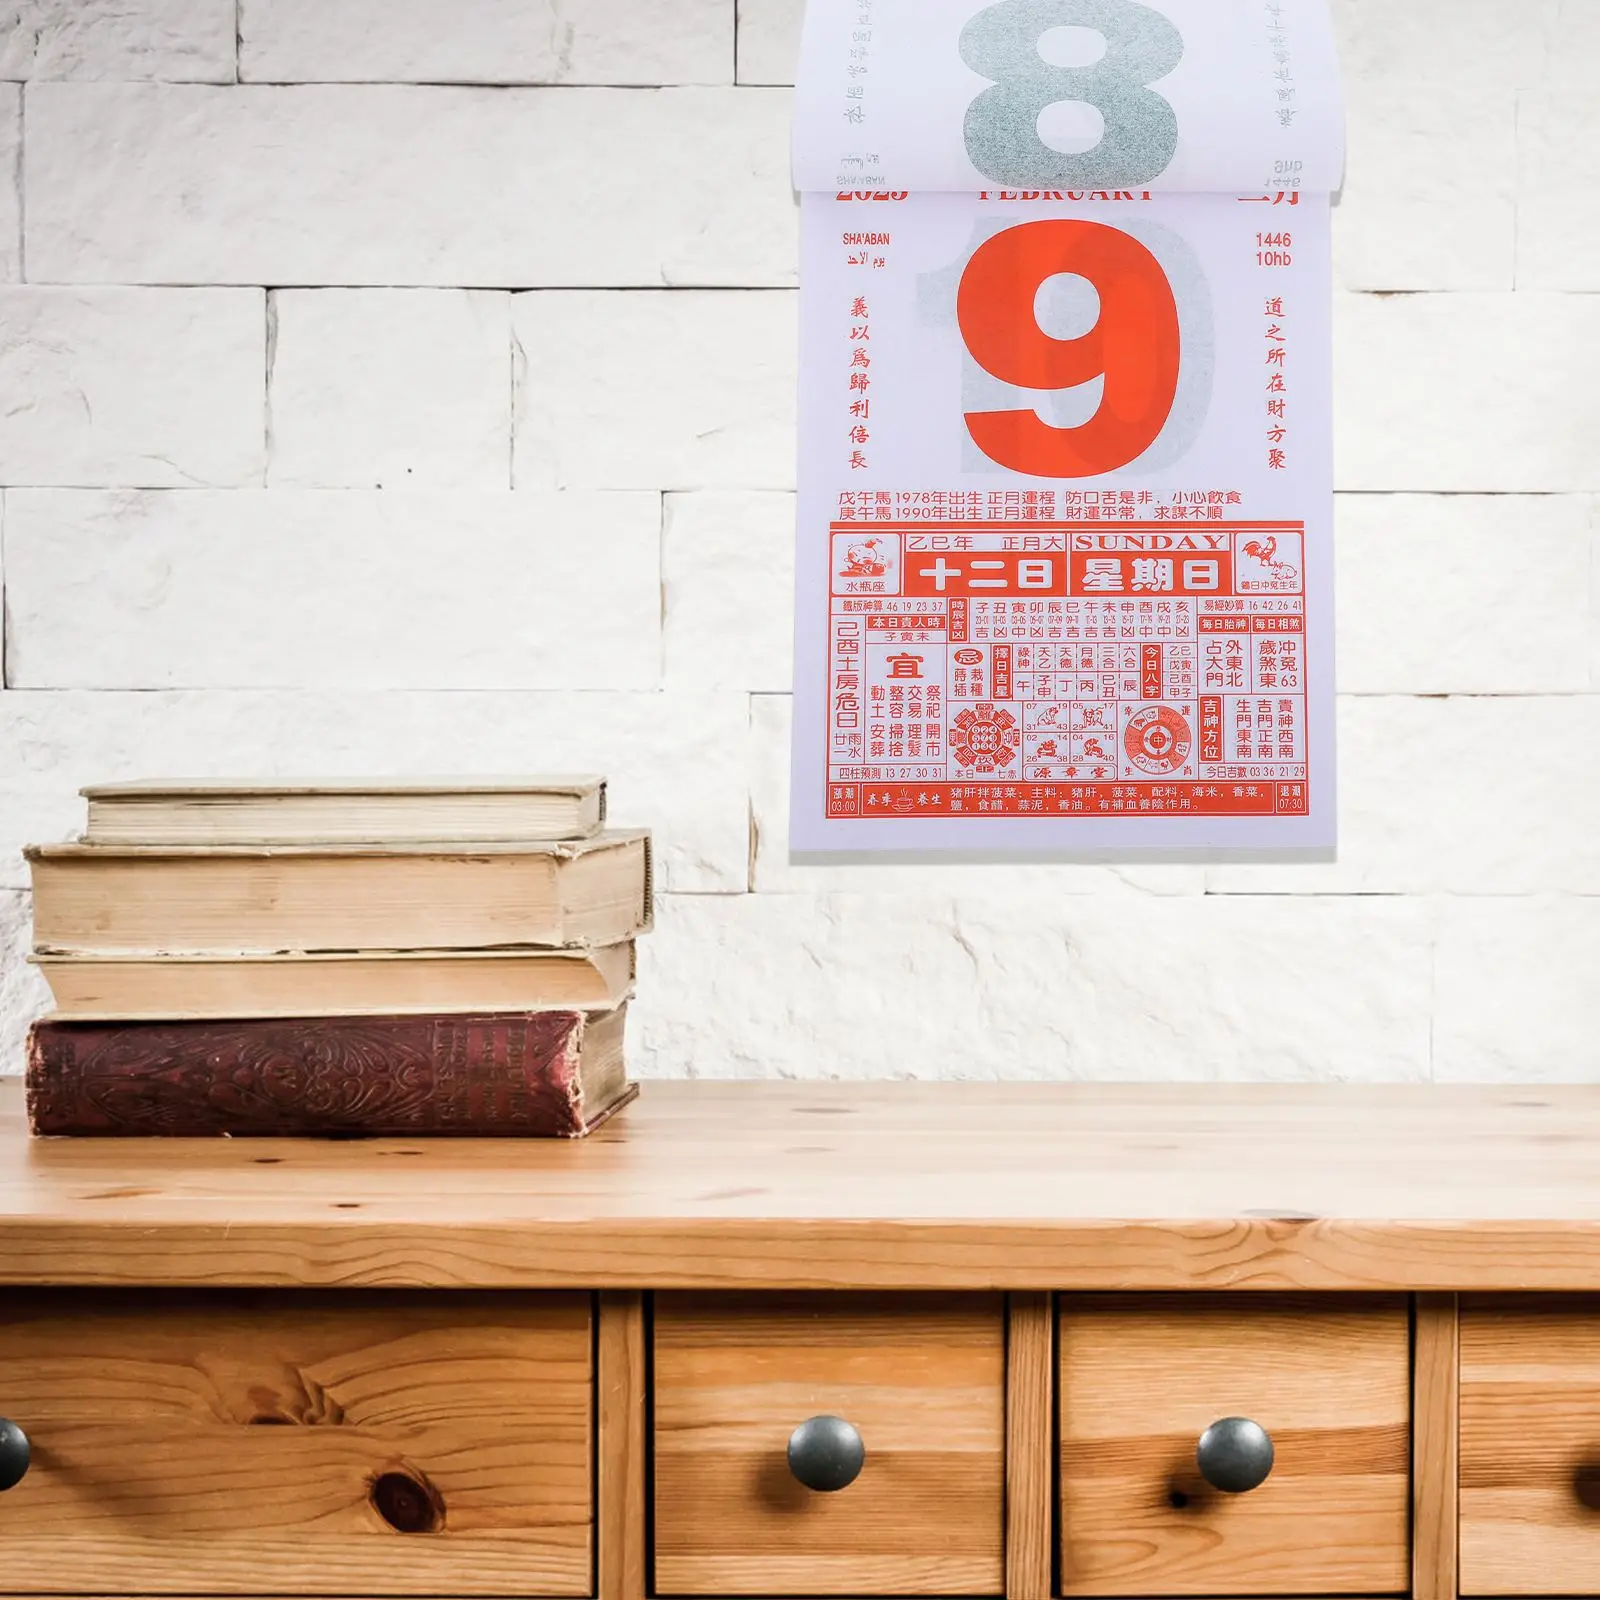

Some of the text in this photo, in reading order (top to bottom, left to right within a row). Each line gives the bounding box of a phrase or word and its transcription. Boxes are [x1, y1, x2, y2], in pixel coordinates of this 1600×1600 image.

[842, 232, 890, 245] SHA'ABAN
[1256, 232, 1292, 247] 1446
[1256, 251, 1292, 266] 10hb
[956, 218, 1181, 479] 9
[1264, 296, 1287, 470] 道之所在財方聚
[908, 536, 1063, 550] 乙巳年 正月大
[1075, 535, 1225, 550] SUNDAY
[919, 557, 1053, 591] 十二日
[1081, 558, 1219, 592] 星期日
[845, 581, 886, 593] 水瓶座
[886, 601, 898, 612] 46
[903, 601, 912, 612] 19
[916, 601, 928, 612] 23
[931, 601, 943, 612] 37
[1249, 601, 1258, 611] 16
[1262, 601, 1274, 611] 42
[1277, 601, 1289, 611] 26
[1292, 601, 1302, 611] 41
[872, 616, 941, 628] 本日貴人時
[951, 600, 965, 640] 時辰吉凶
[885, 632, 930, 641] 子寅未
[959, 651, 979, 663] 忌
[1038, 647, 1051, 669] 天乙
[1102, 647, 1115, 668] 三合
[1123, 647, 1136, 668] 六合
[886, 652, 924, 679] 宜
[1145, 647, 1158, 696] 今日八字
[1016, 680, 1030, 692] 午
[1059, 680, 1072, 692] 丁
[1080, 680, 1094, 692] 丙
[1123, 680, 1136, 692] 辰
[1169, 688, 1191, 698] 甲子
[1203, 700, 1219, 759] 吉神方位
[1237, 700, 1252, 758] 生門東南
[1257, 700, 1273, 758] 吉門正南
[1278, 700, 1294, 758] 貴神西南
[848, 733, 862, 759] 雨水
[840, 768, 942, 779] 四柱預測 13 27 30 31
[1250, 766, 1261, 776] 03
[1263, 766, 1275, 776] 36
[1279, 766, 1289, 776] 21
[1294, 766, 1305, 776] 29
[831, 801, 856, 812] 03:00
[1279, 799, 1302, 809] 07:30
